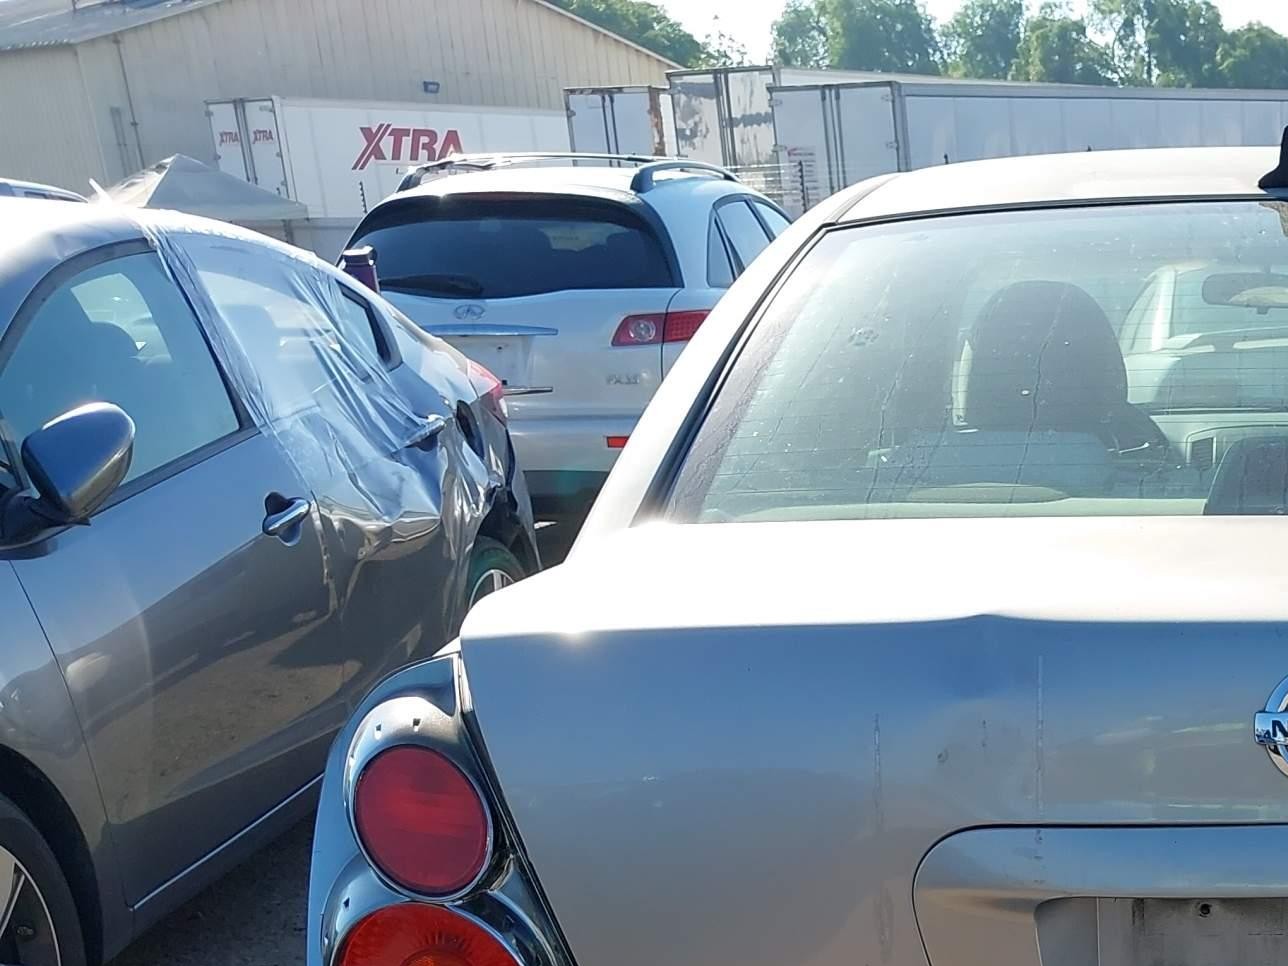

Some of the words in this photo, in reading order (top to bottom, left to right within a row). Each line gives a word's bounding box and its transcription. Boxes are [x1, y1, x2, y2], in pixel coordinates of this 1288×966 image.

[219, 131, 240, 146] XTRA
[252, 129, 274, 144] XTRA
[352, 123, 464, 170] XTRA
